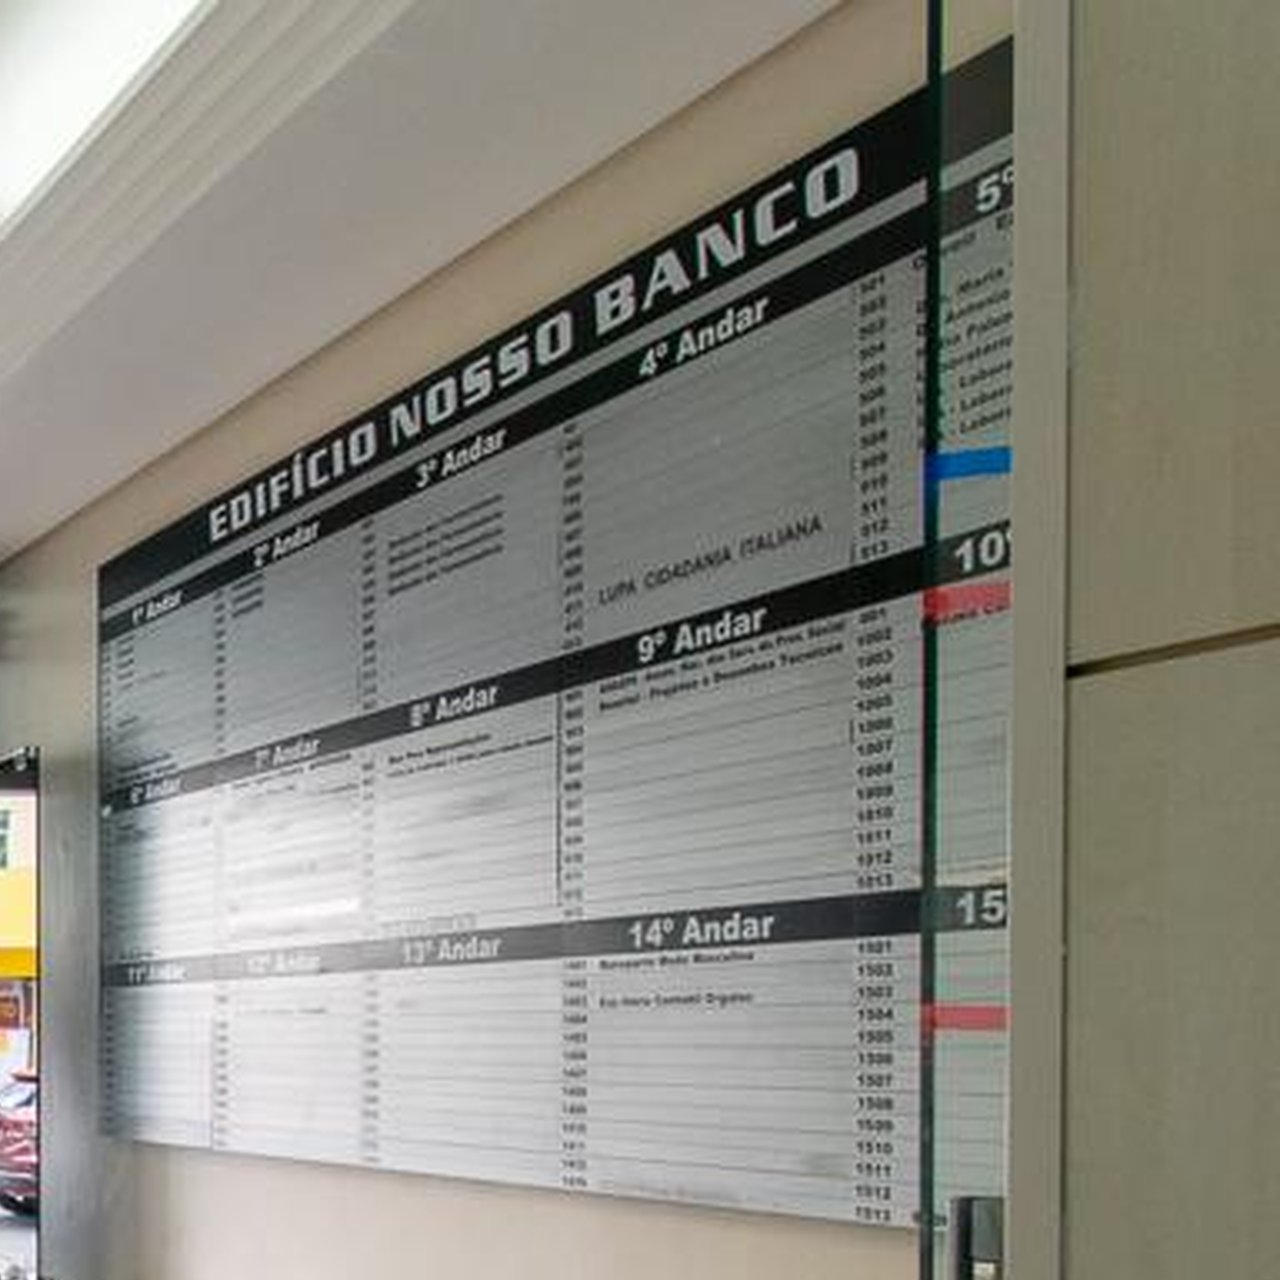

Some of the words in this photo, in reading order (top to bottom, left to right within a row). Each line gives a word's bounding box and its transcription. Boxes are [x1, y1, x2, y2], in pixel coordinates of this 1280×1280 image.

[208, 422, 379, 541] EDIFÍCIO
[389, 311, 573, 447] NOSSO
[593, 148, 860, 336] BANCO
[676, 297, 769, 363] Andar
[443, 429, 507, 476] Andar
[273, 519, 320, 559] Andar
[598, 579, 637, 605] LUPA
[643, 546, 732, 589] CIDADANIA
[740, 514, 822, 557] ITALIANA
[638, 629, 668, 664] 9º
[673, 606, 768, 655] Andar
[434, 685, 500, 722] Andar
[438, 935, 503, 962] Andar
[628, 917, 675, 948] 14º
[682, 912, 776, 944] Andar
